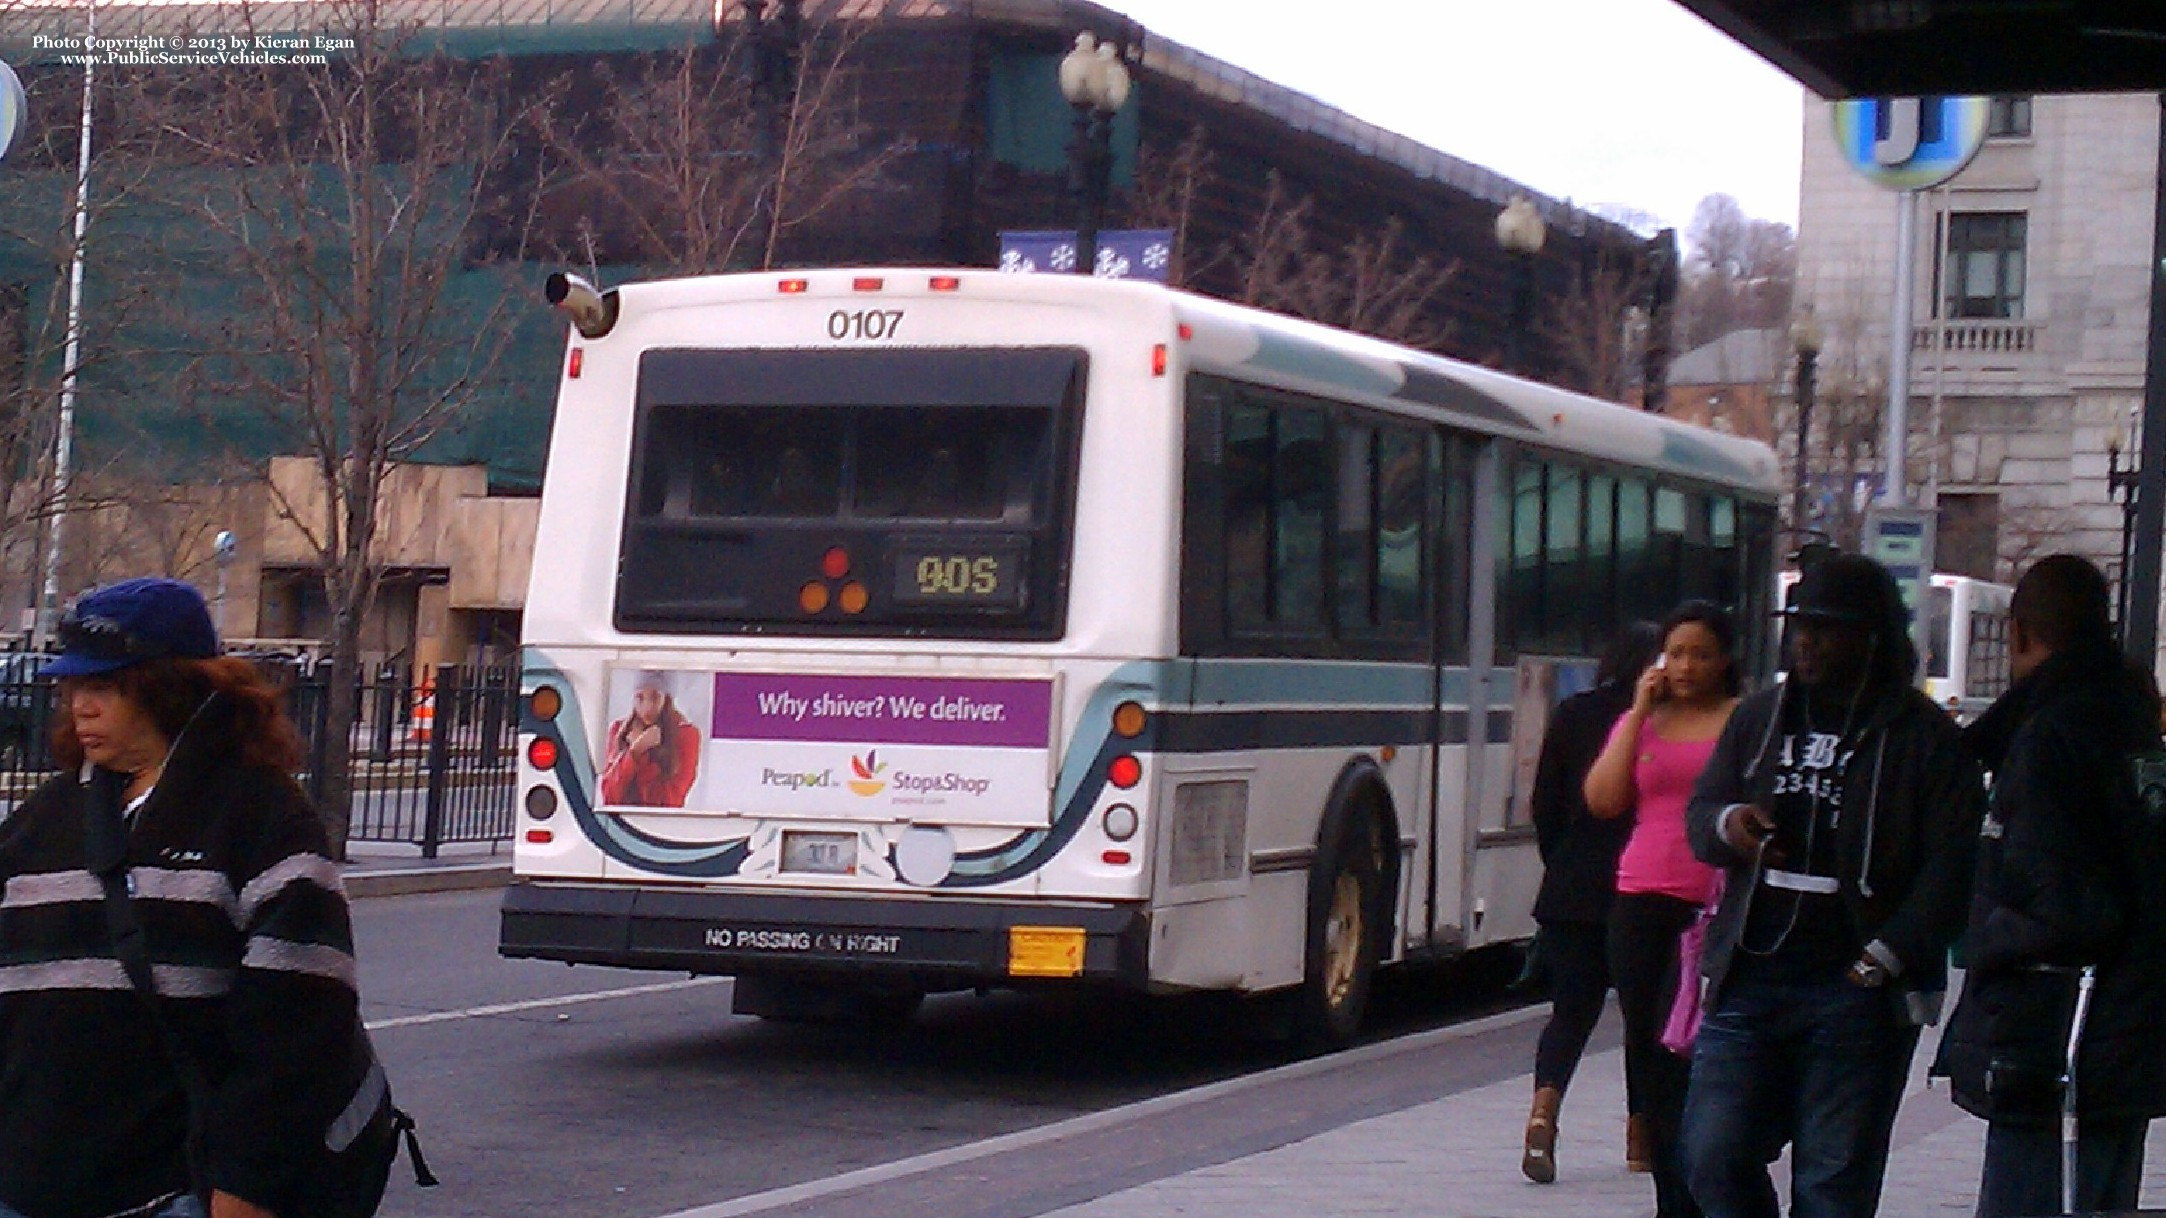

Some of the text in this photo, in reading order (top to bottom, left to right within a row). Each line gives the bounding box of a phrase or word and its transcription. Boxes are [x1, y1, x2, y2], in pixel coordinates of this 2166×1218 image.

[828, 309, 904, 339] 0107
[758, 692, 1006, 721] Why shiver? We deliver.
[761, 768, 830, 791] Peapod
[705, 928, 732, 947] NO
[736, 931, 810, 950] PASSING
